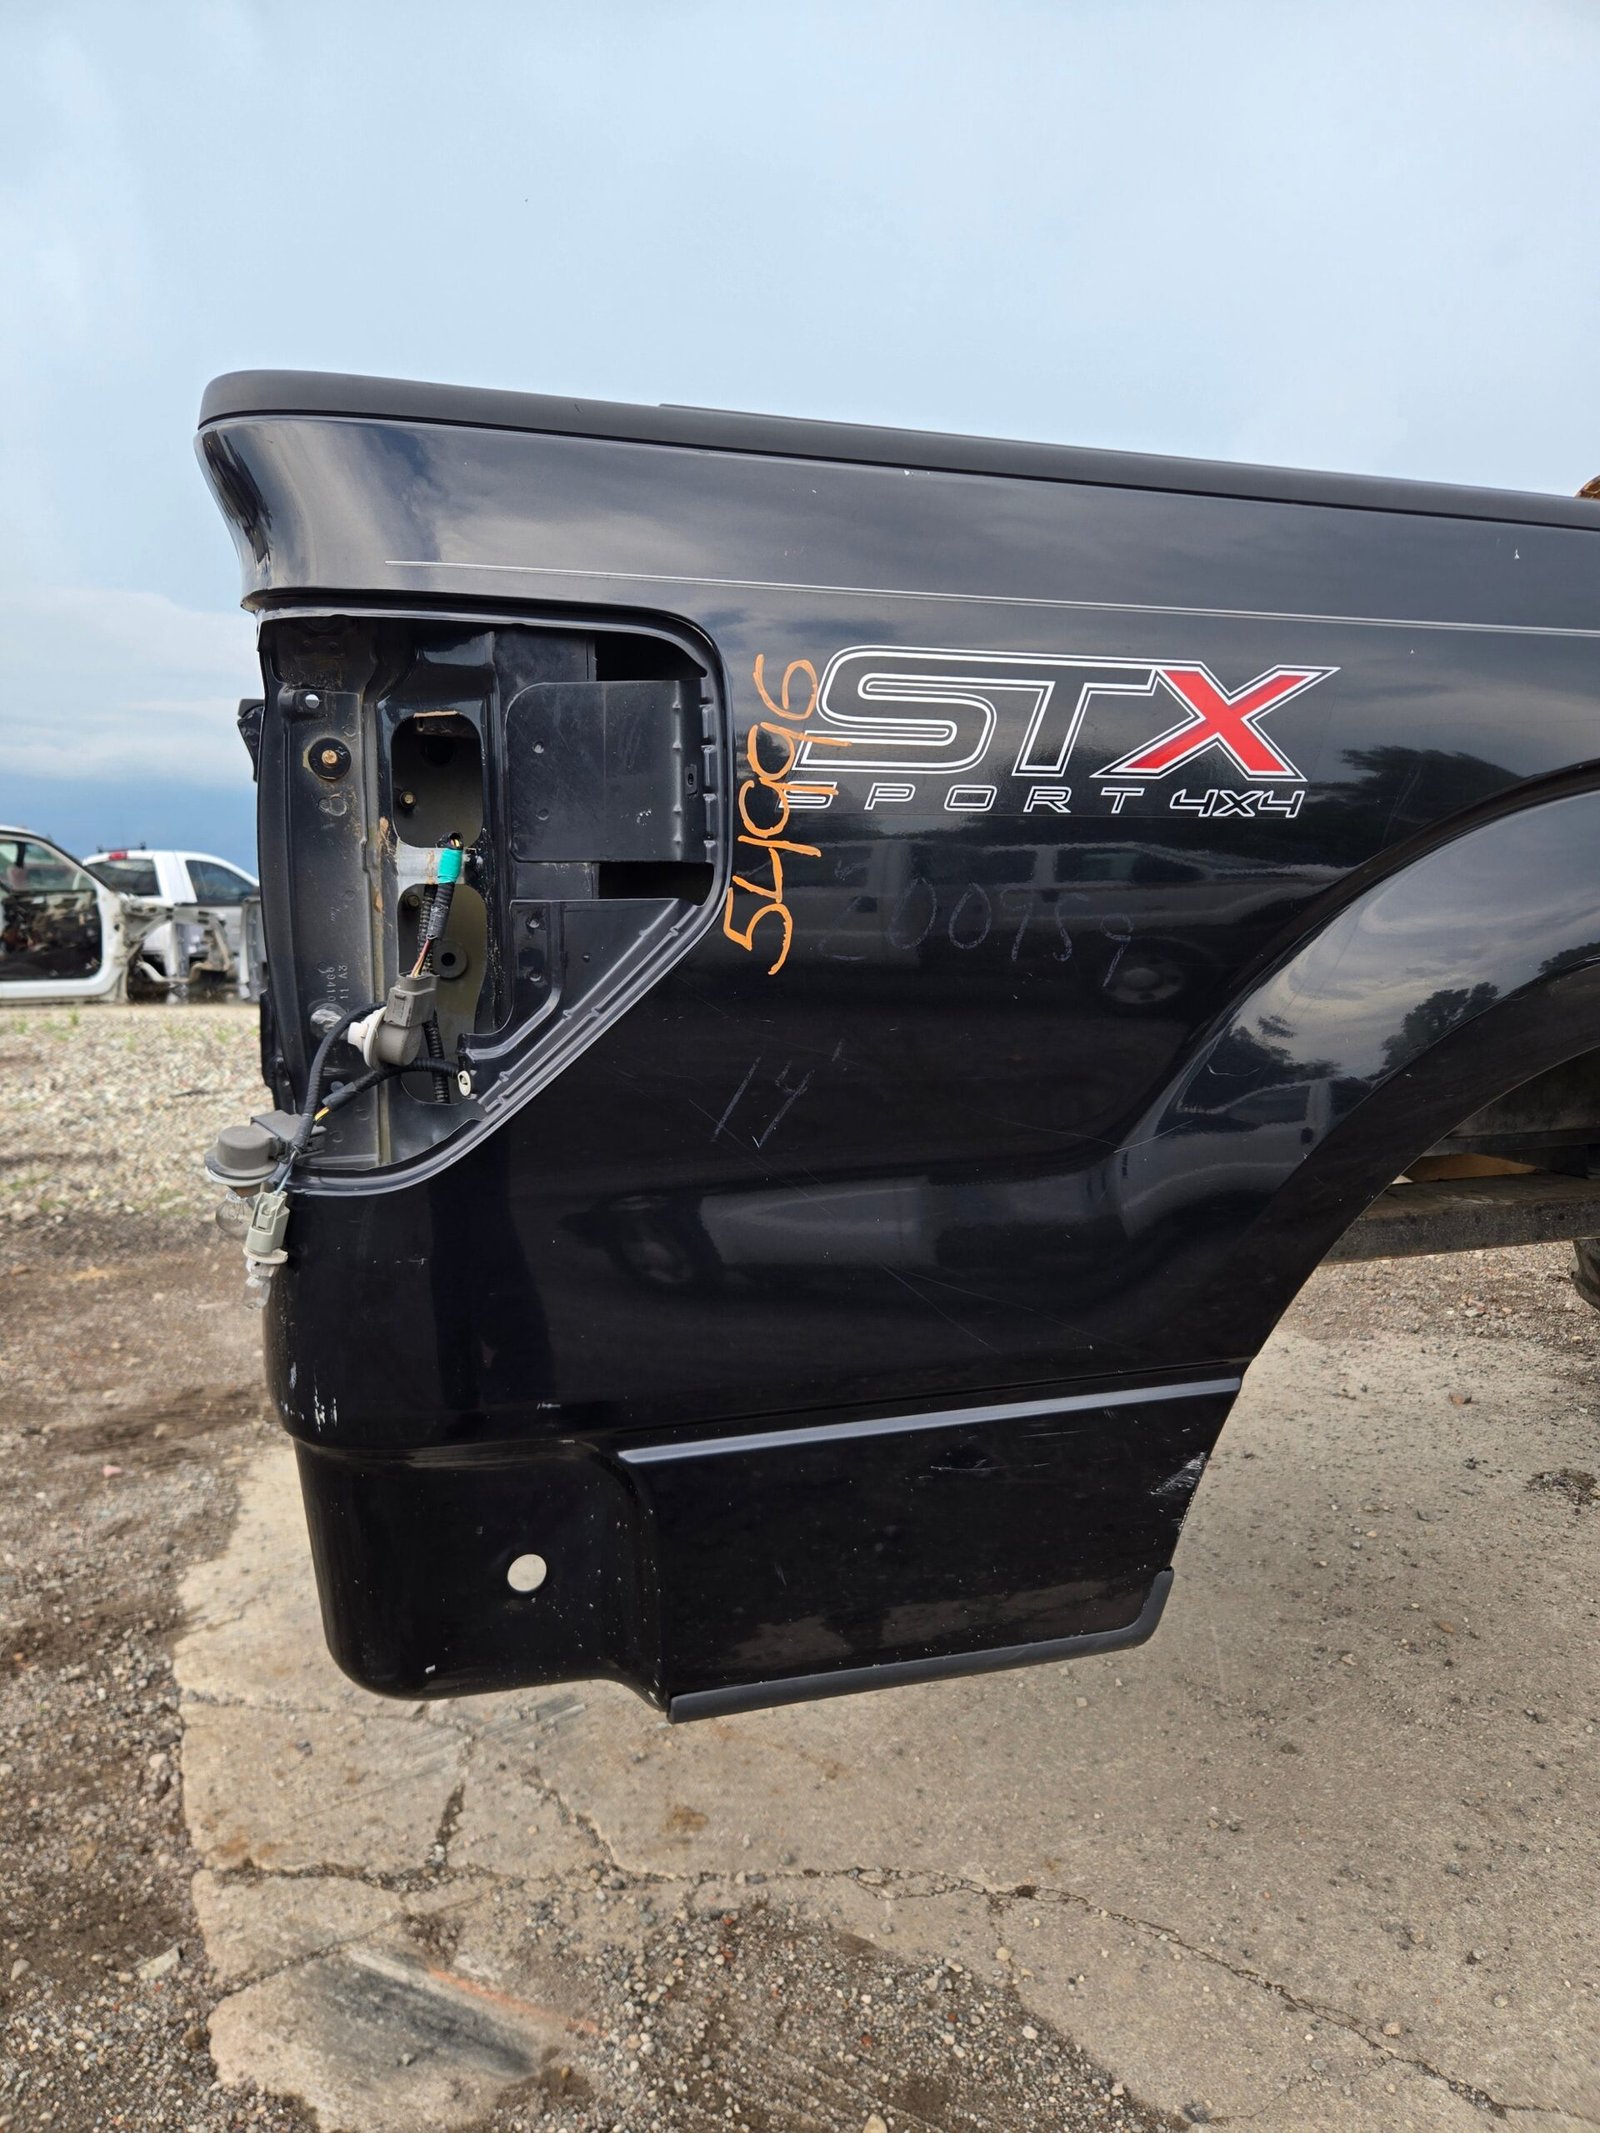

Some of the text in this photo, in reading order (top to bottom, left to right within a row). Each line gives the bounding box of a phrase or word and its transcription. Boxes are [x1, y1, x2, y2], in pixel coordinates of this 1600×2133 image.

[792, 645, 1341, 782] STX
[723, 653, 851, 977] 54996
[778, 780, 1146, 815] SPORT
